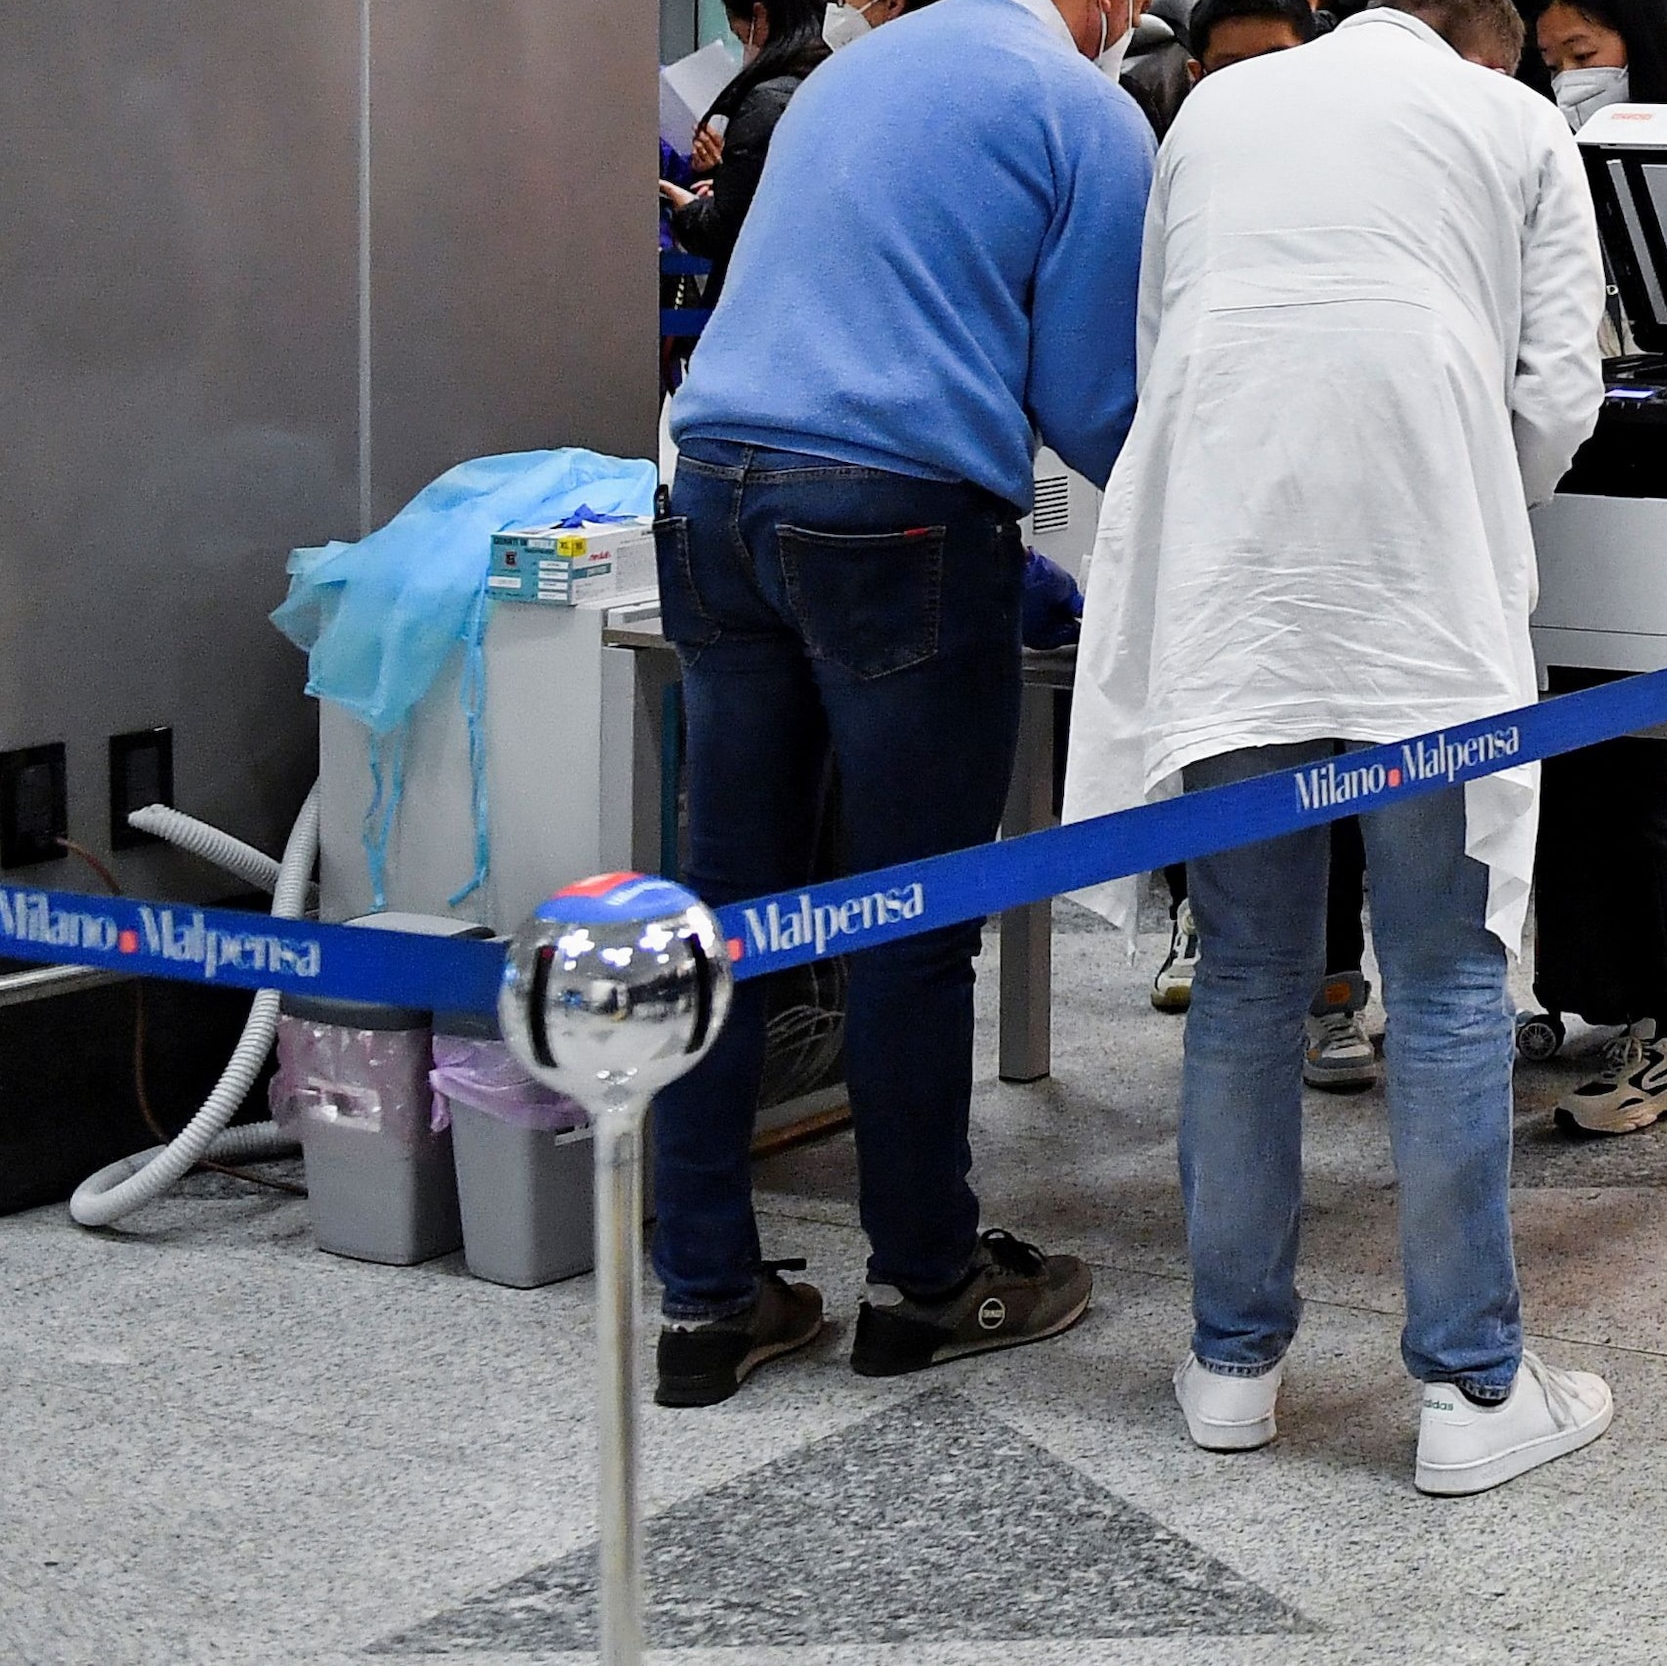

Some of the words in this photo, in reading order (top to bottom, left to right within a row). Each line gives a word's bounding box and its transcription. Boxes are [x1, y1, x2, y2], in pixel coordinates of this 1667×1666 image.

[1294, 763, 1386, 812] Milano
[1400, 725, 1521, 782] Malpensa
[138, 905, 321, 978] Malpensa
[743, 882, 925, 958] Malpensa
